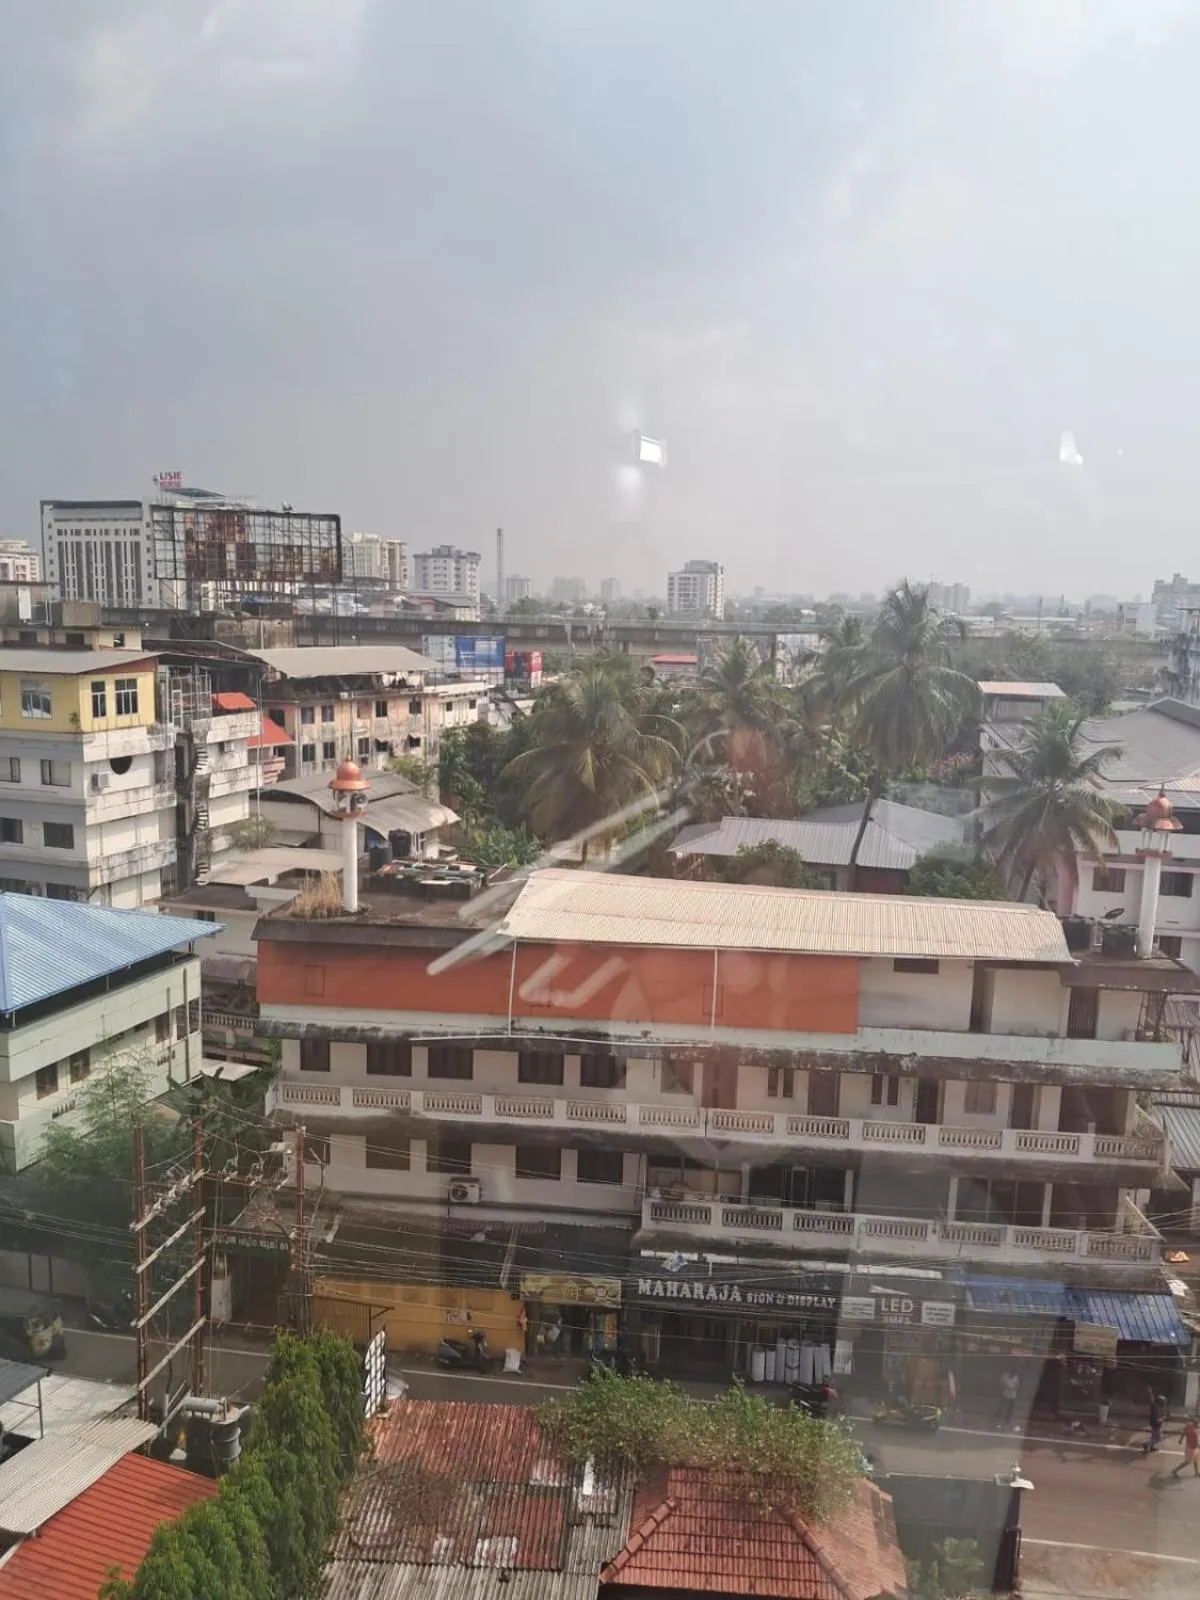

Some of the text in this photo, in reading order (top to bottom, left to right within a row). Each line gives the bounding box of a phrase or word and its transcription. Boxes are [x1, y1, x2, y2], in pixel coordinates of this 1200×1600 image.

[638, 1279, 742, 1302] MAHARAJA
[746, 1292, 774, 1304] SIGN
[787, 1294, 836, 1309] DISPLAY
[881, 1297, 914, 1313] LED
